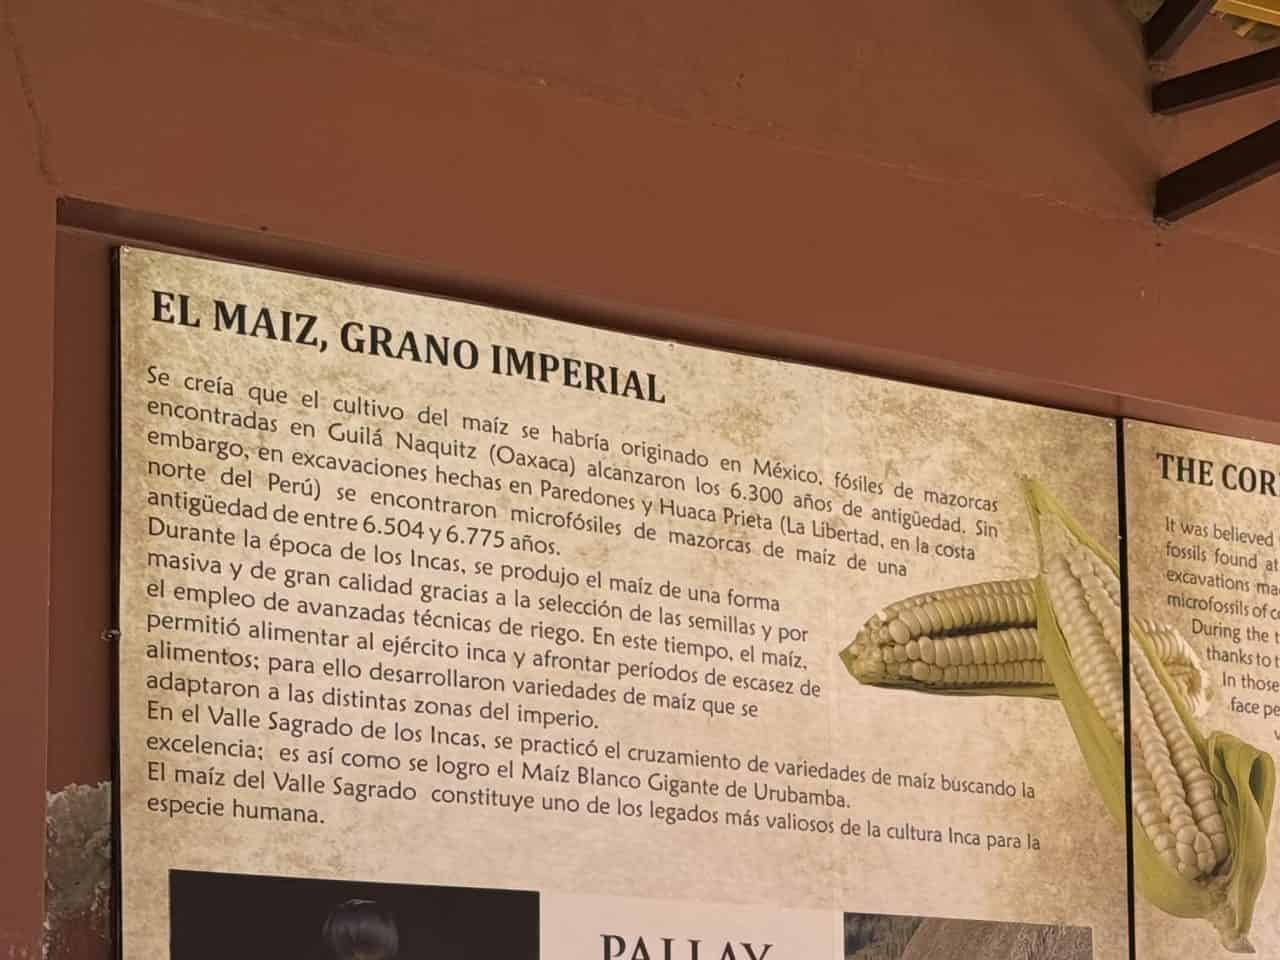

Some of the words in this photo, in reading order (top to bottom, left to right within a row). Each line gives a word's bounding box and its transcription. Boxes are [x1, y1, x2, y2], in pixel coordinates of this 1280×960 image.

[151, 289, 200, 328] EL
[213, 299, 327, 353] MAIZ,
[340, 321, 478, 370] GRANO
[491, 344, 665, 404] IMPERIAL
[147, 366, 170, 386] Se
[184, 376, 234, 396] creía
[248, 386, 288, 405] que
[301, 390, 319, 408] el
[333, 396, 404, 421] cultivo
[417, 405, 448, 427] del
[462, 415, 509, 435] maíz
[521, 425, 539, 440] se
[552, 425, 609, 451] habría
[621, 440, 708, 468] originado
[720, 457, 741, 472] en
[834, 471, 883, 495] fósiles
[893, 480, 913, 500] de
[924, 489, 998, 512] mazorcas
[1155, 452, 1213, 486] THE
[147, 490, 267, 520] antigüedad
[272, 503, 299, 524] de
[303, 512, 358, 531] entre
[362, 514, 424, 539] 6.504
[428, 527, 442, 545] y
[446, 524, 504, 548] 6.775
[510, 534, 560, 556] años.
[1166, 516, 1176, 532] It
[1181, 525, 1208, 537] was
[1213, 523, 1273, 547] believed
[146, 671, 259, 699] adaptaron
[268, 686, 279, 700] a
[288, 682, 314, 704] las
[321, 686, 406, 712] distintas
[414, 699, 472, 718] zonas
[479, 700, 509, 720] del
[517, 704, 598, 729] imperio.
[147, 796, 224, 818] especie
[232, 797, 324, 824] humana.
